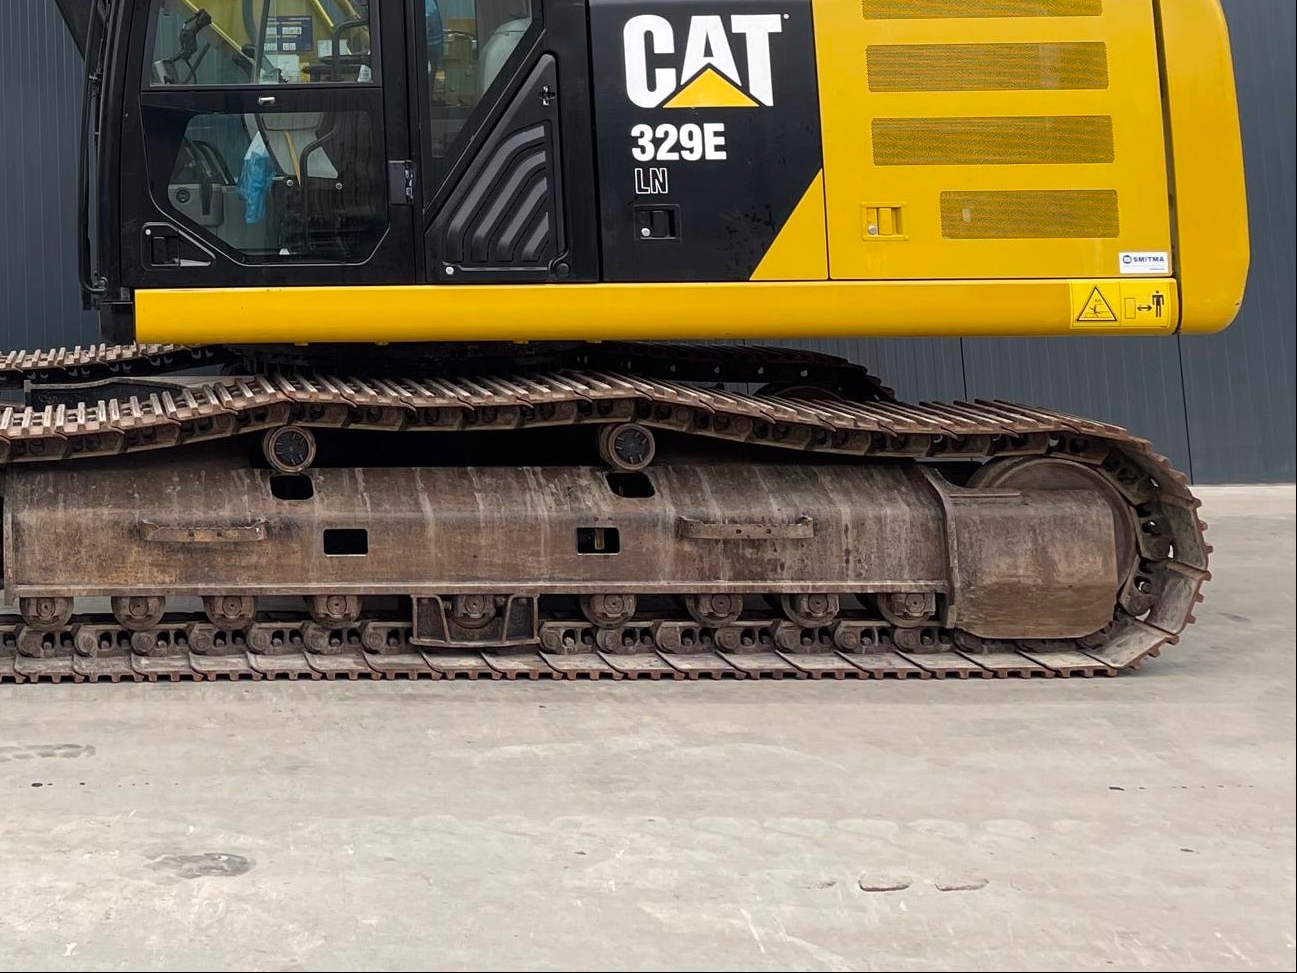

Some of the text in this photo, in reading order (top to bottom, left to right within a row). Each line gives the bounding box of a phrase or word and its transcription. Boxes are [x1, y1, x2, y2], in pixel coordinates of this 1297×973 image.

[623, 13, 783, 109] CAT
[630, 122, 728, 162] 329E
[634, 167, 669, 195] LN
